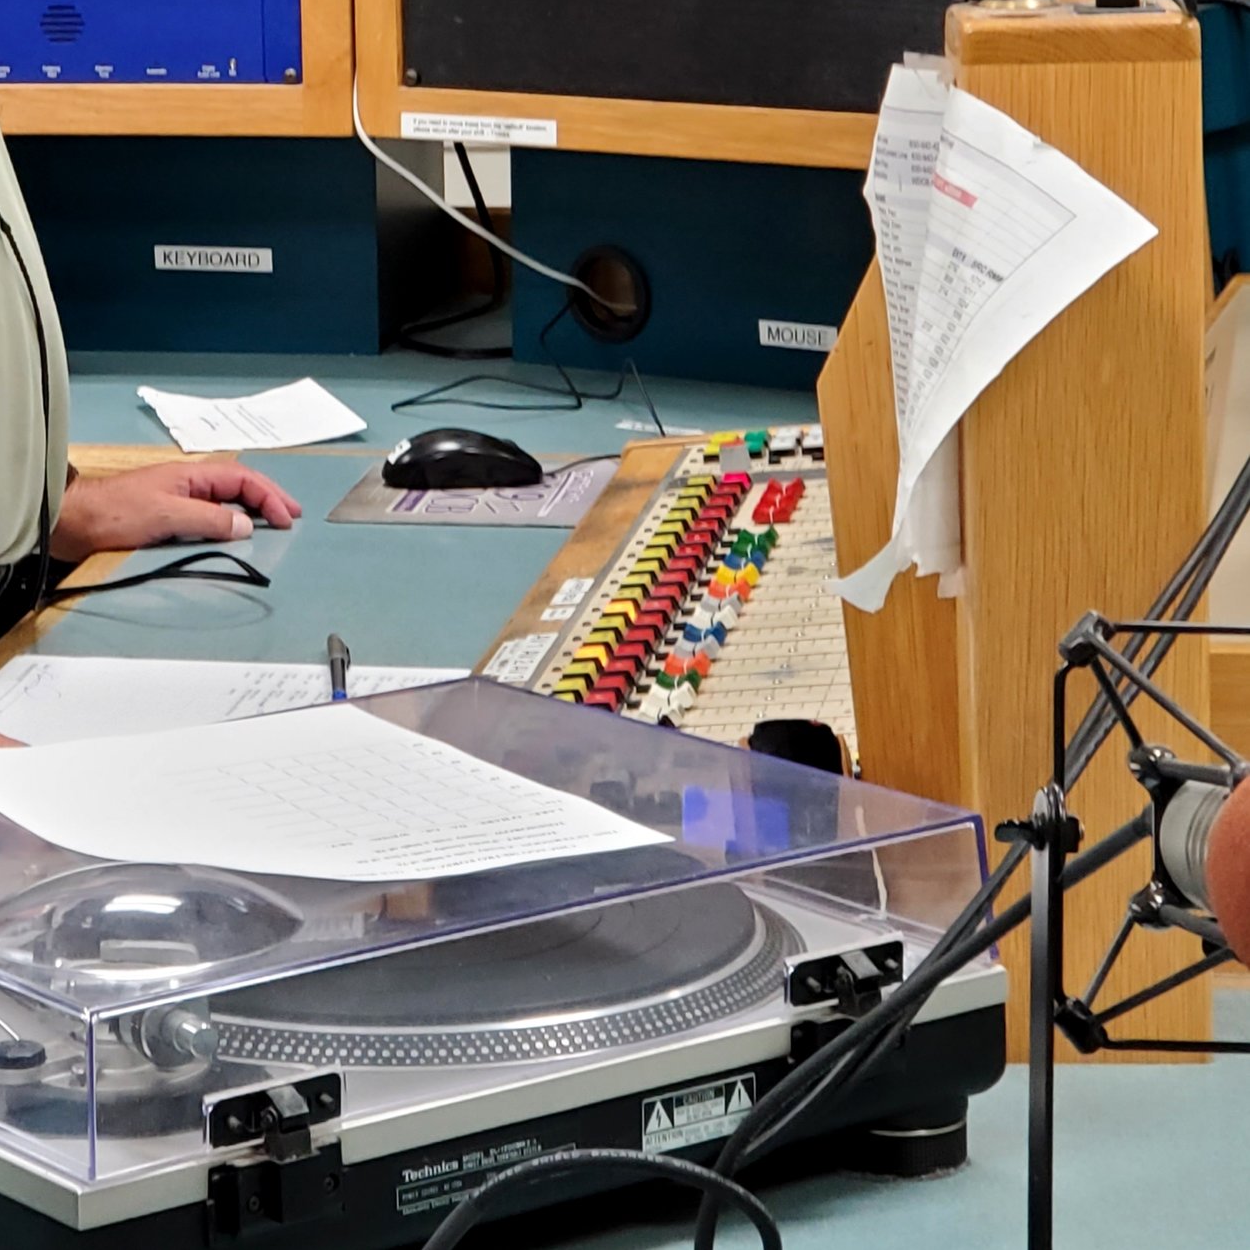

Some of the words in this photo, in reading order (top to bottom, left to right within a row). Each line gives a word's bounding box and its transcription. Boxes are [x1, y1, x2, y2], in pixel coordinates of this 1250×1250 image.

[163, 251, 260, 268] KEYBOARD
[767, 326, 828, 346] MOUSE
[646, 1130, 684, 1146] ATTENTION
[402, 1160, 460, 1183] Technics
